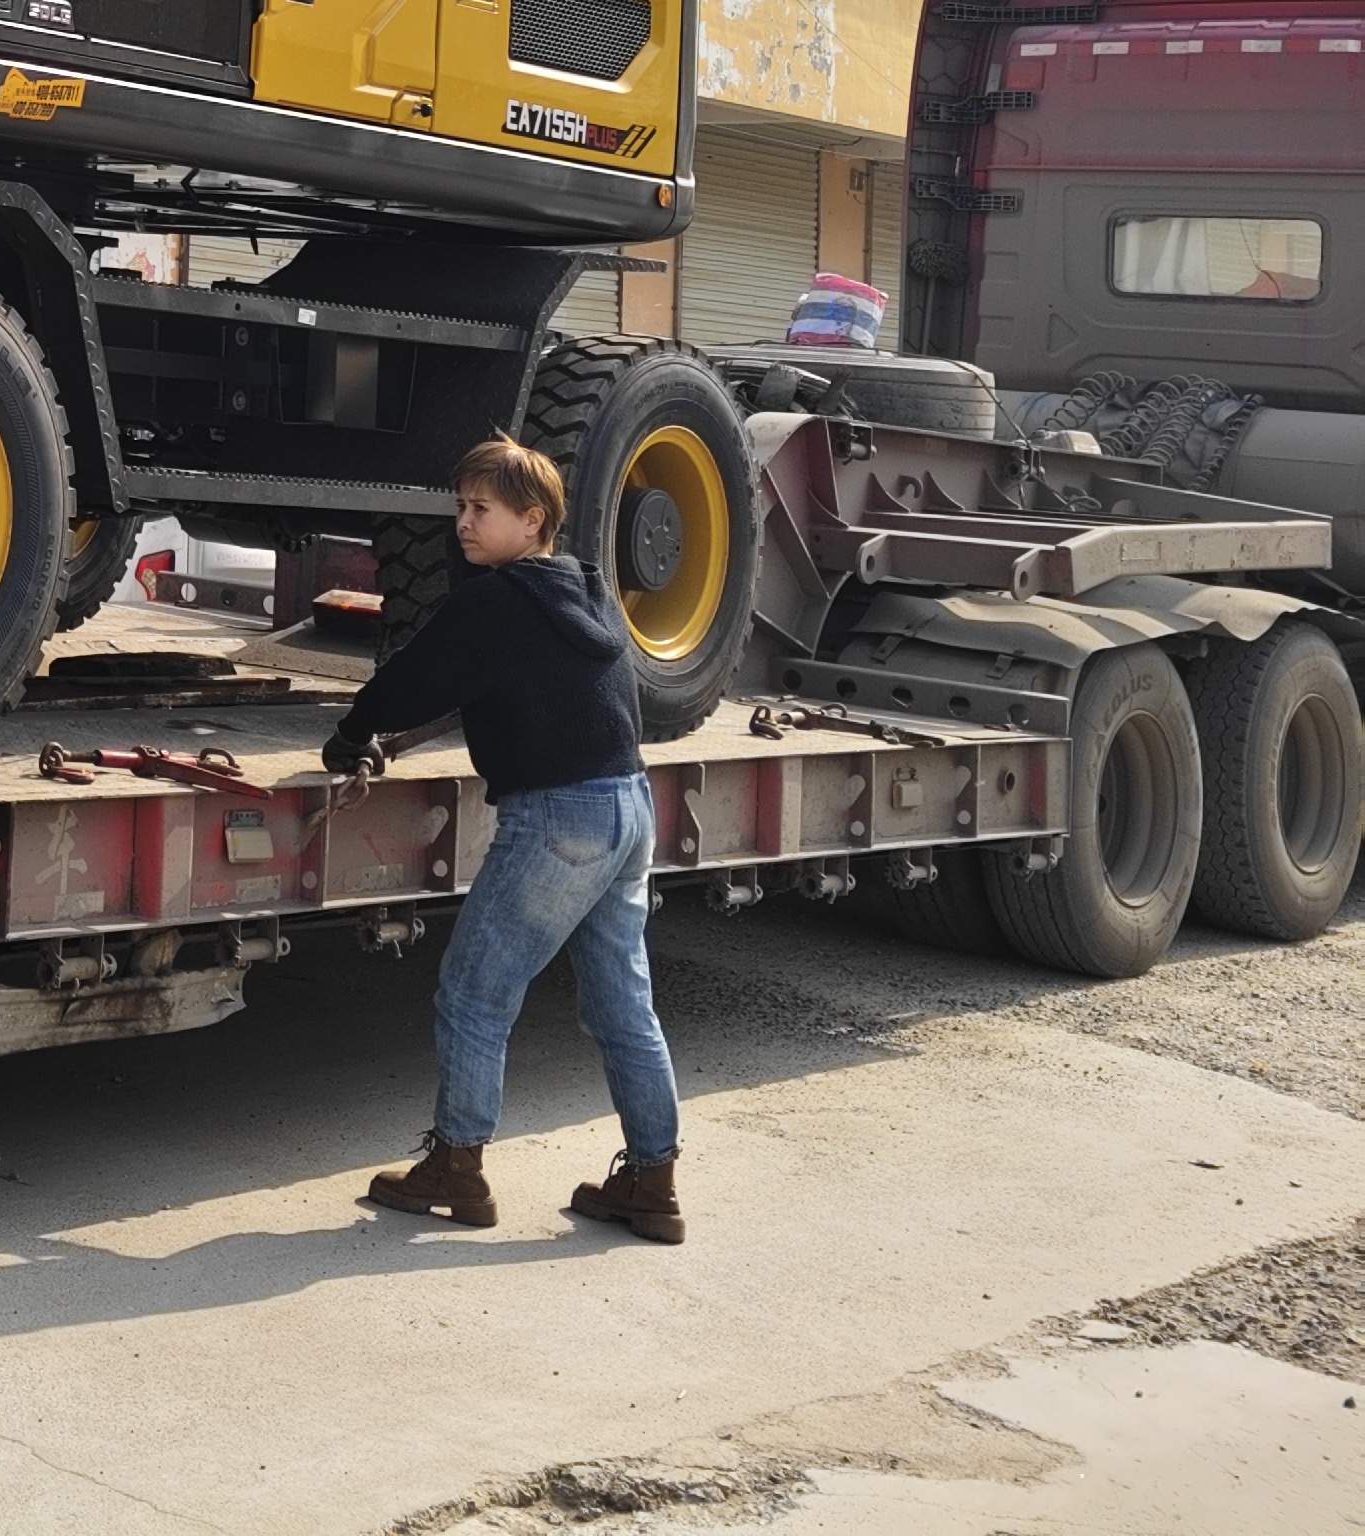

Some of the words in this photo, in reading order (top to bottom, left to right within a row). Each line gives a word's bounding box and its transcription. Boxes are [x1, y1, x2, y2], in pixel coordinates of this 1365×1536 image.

[28, 2, 72, 25] SDLG
[505, 99, 588, 145] EA7155H
[587, 125, 619, 150] PLUS
